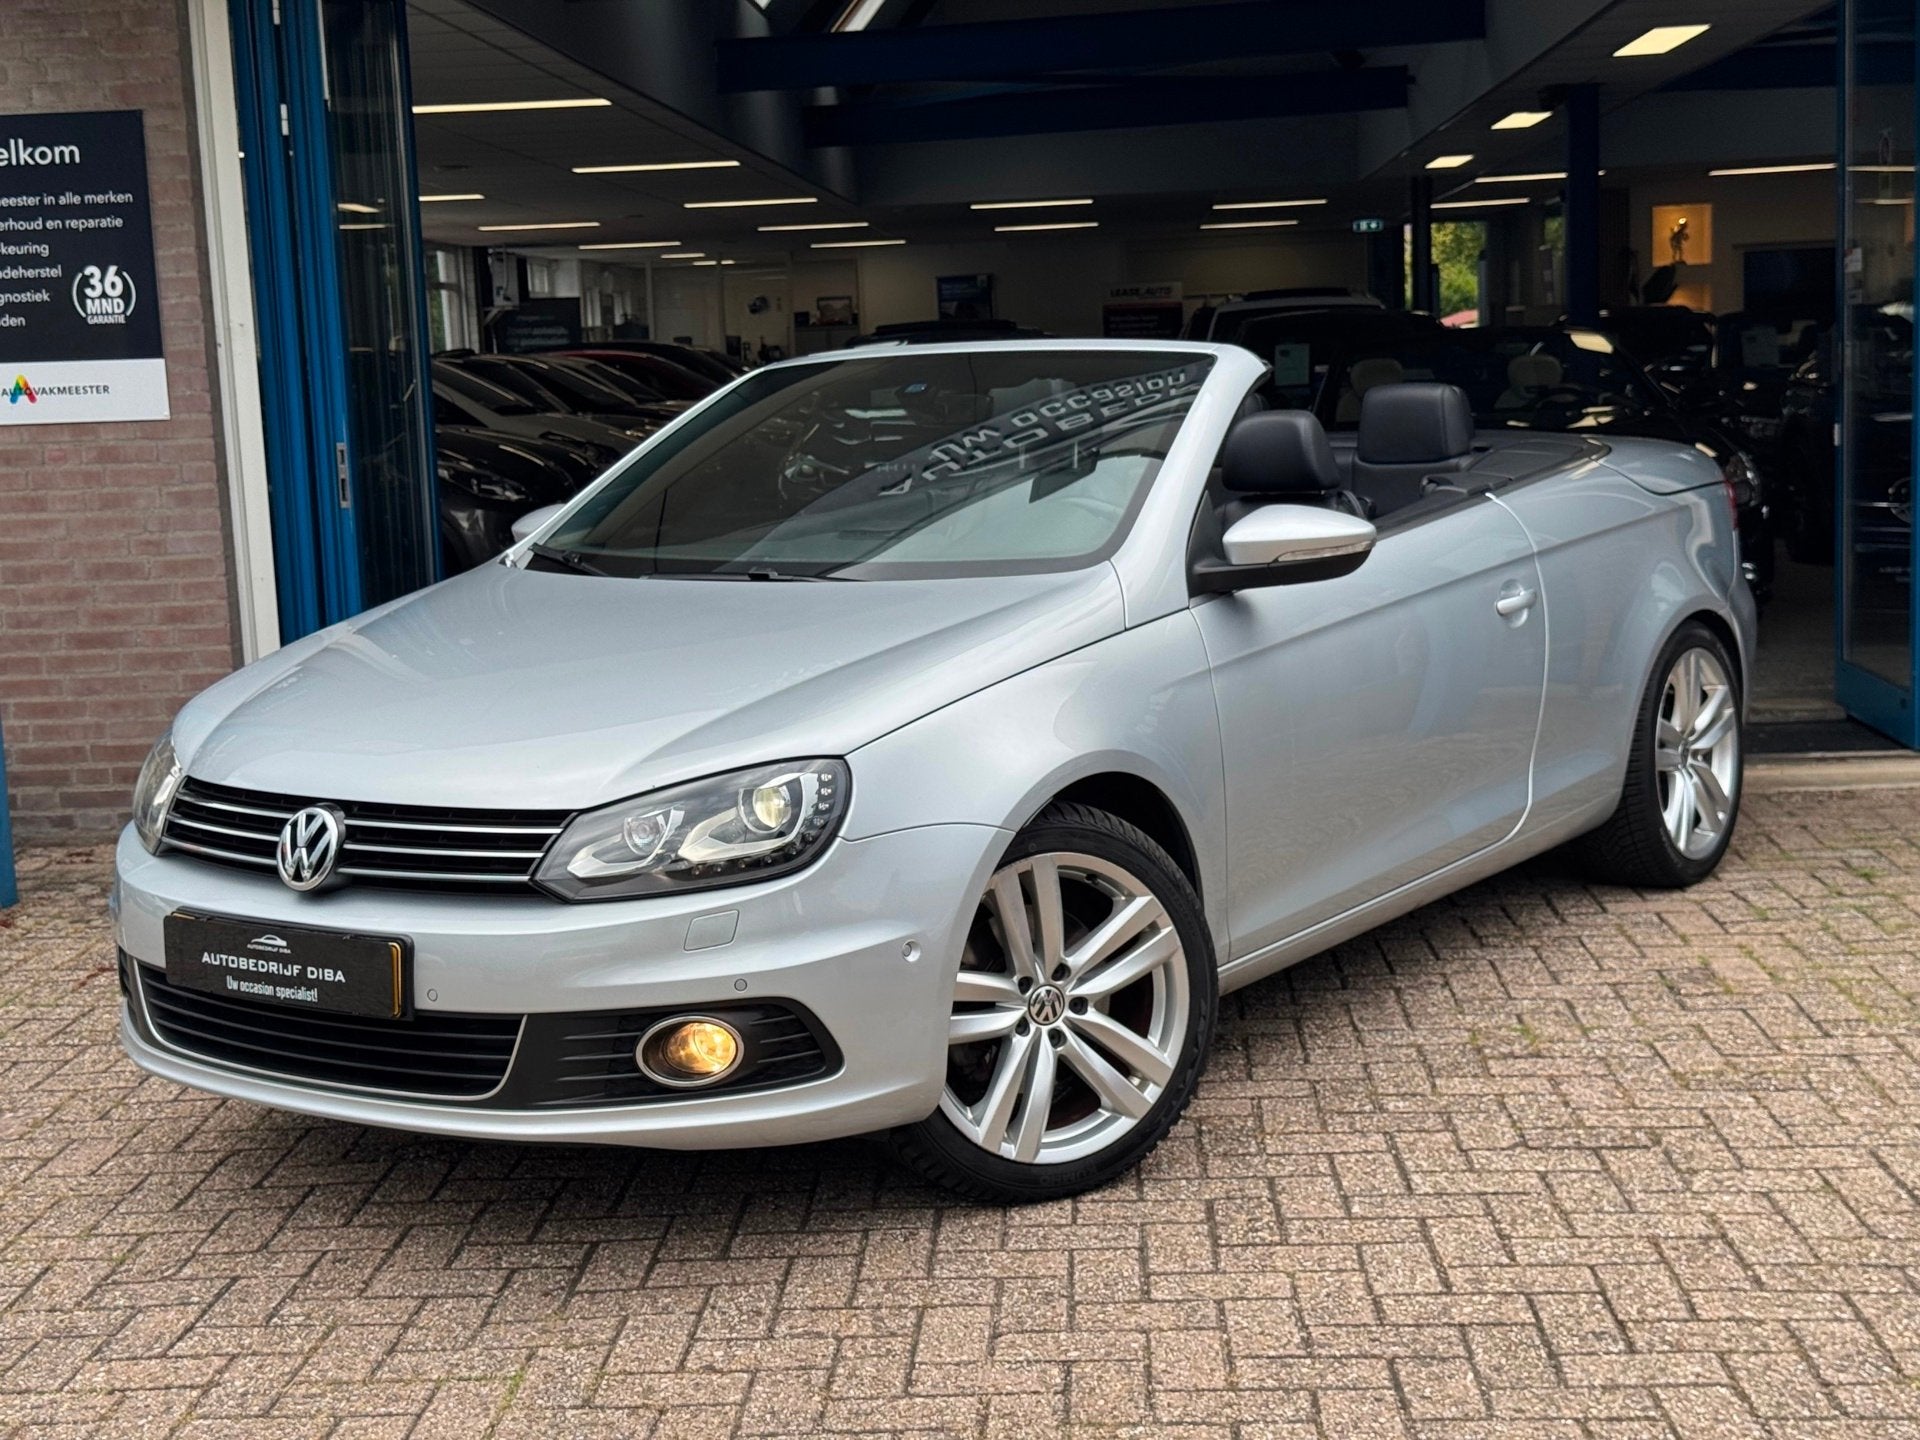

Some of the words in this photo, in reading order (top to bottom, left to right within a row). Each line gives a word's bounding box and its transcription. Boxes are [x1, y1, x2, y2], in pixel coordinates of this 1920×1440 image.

[0, 195, 40, 208] eester
[43, 192, 55, 206] in
[58, 191, 81, 206] alle
[84, 190, 134, 205] merken
[46, 219, 62, 230] en
[65, 214, 123, 232] reparatie
[0, 241, 49, 258] keuring
[83, 264, 124, 299] 36
[85, 298, 126, 315] MND
[0, 313, 26, 327] den
[86, 313, 126, 325] GARANTIE
[201, 951, 302, 977] AUTOBEDRIJF
[307, 966, 346, 983] DIBA
[226, 975, 239, 991] Uw
[240, 979, 275, 997] occasion
[276, 984, 319, 1003] specialist!
